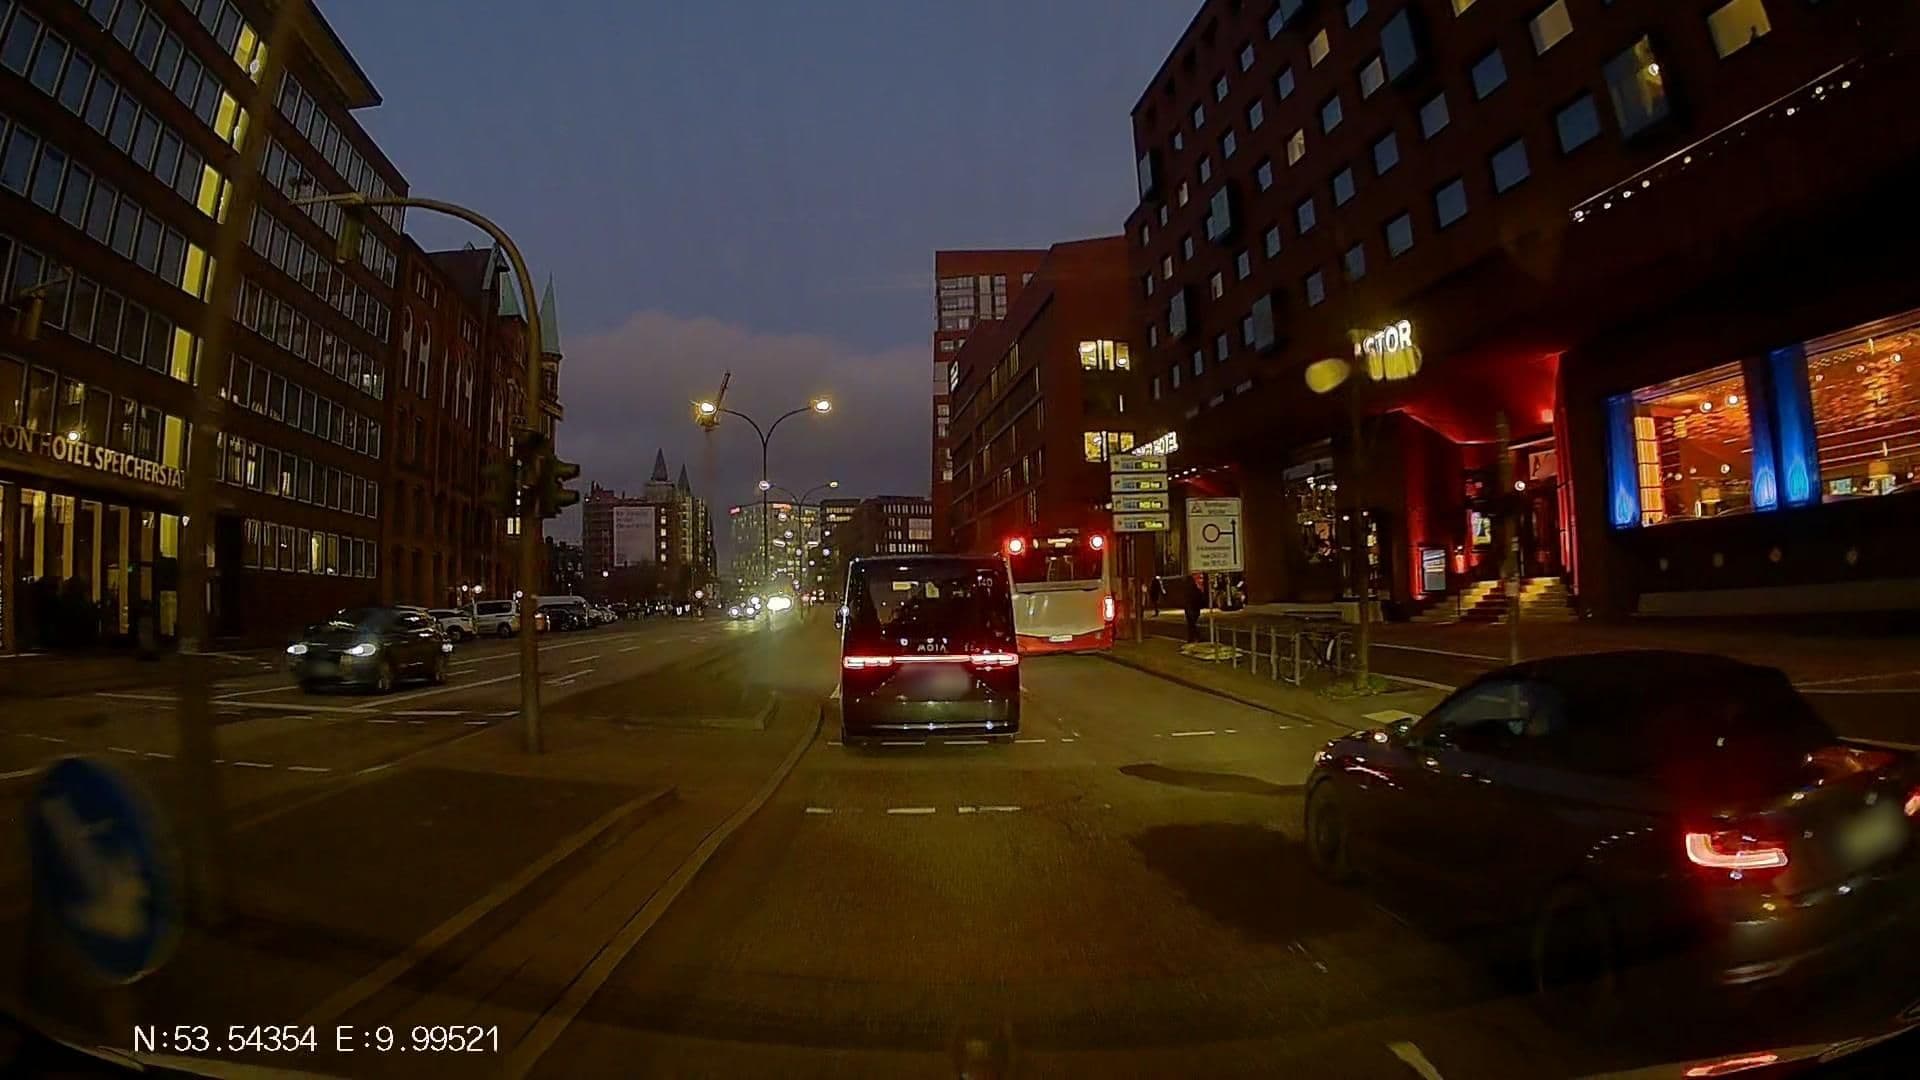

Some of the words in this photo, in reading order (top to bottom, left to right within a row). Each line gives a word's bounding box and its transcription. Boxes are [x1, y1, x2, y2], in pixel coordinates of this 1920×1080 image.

[0, 423, 33, 452] ON
[40, 432, 91, 467] HOTEL
[917, 643, 946, 652] MOIA
